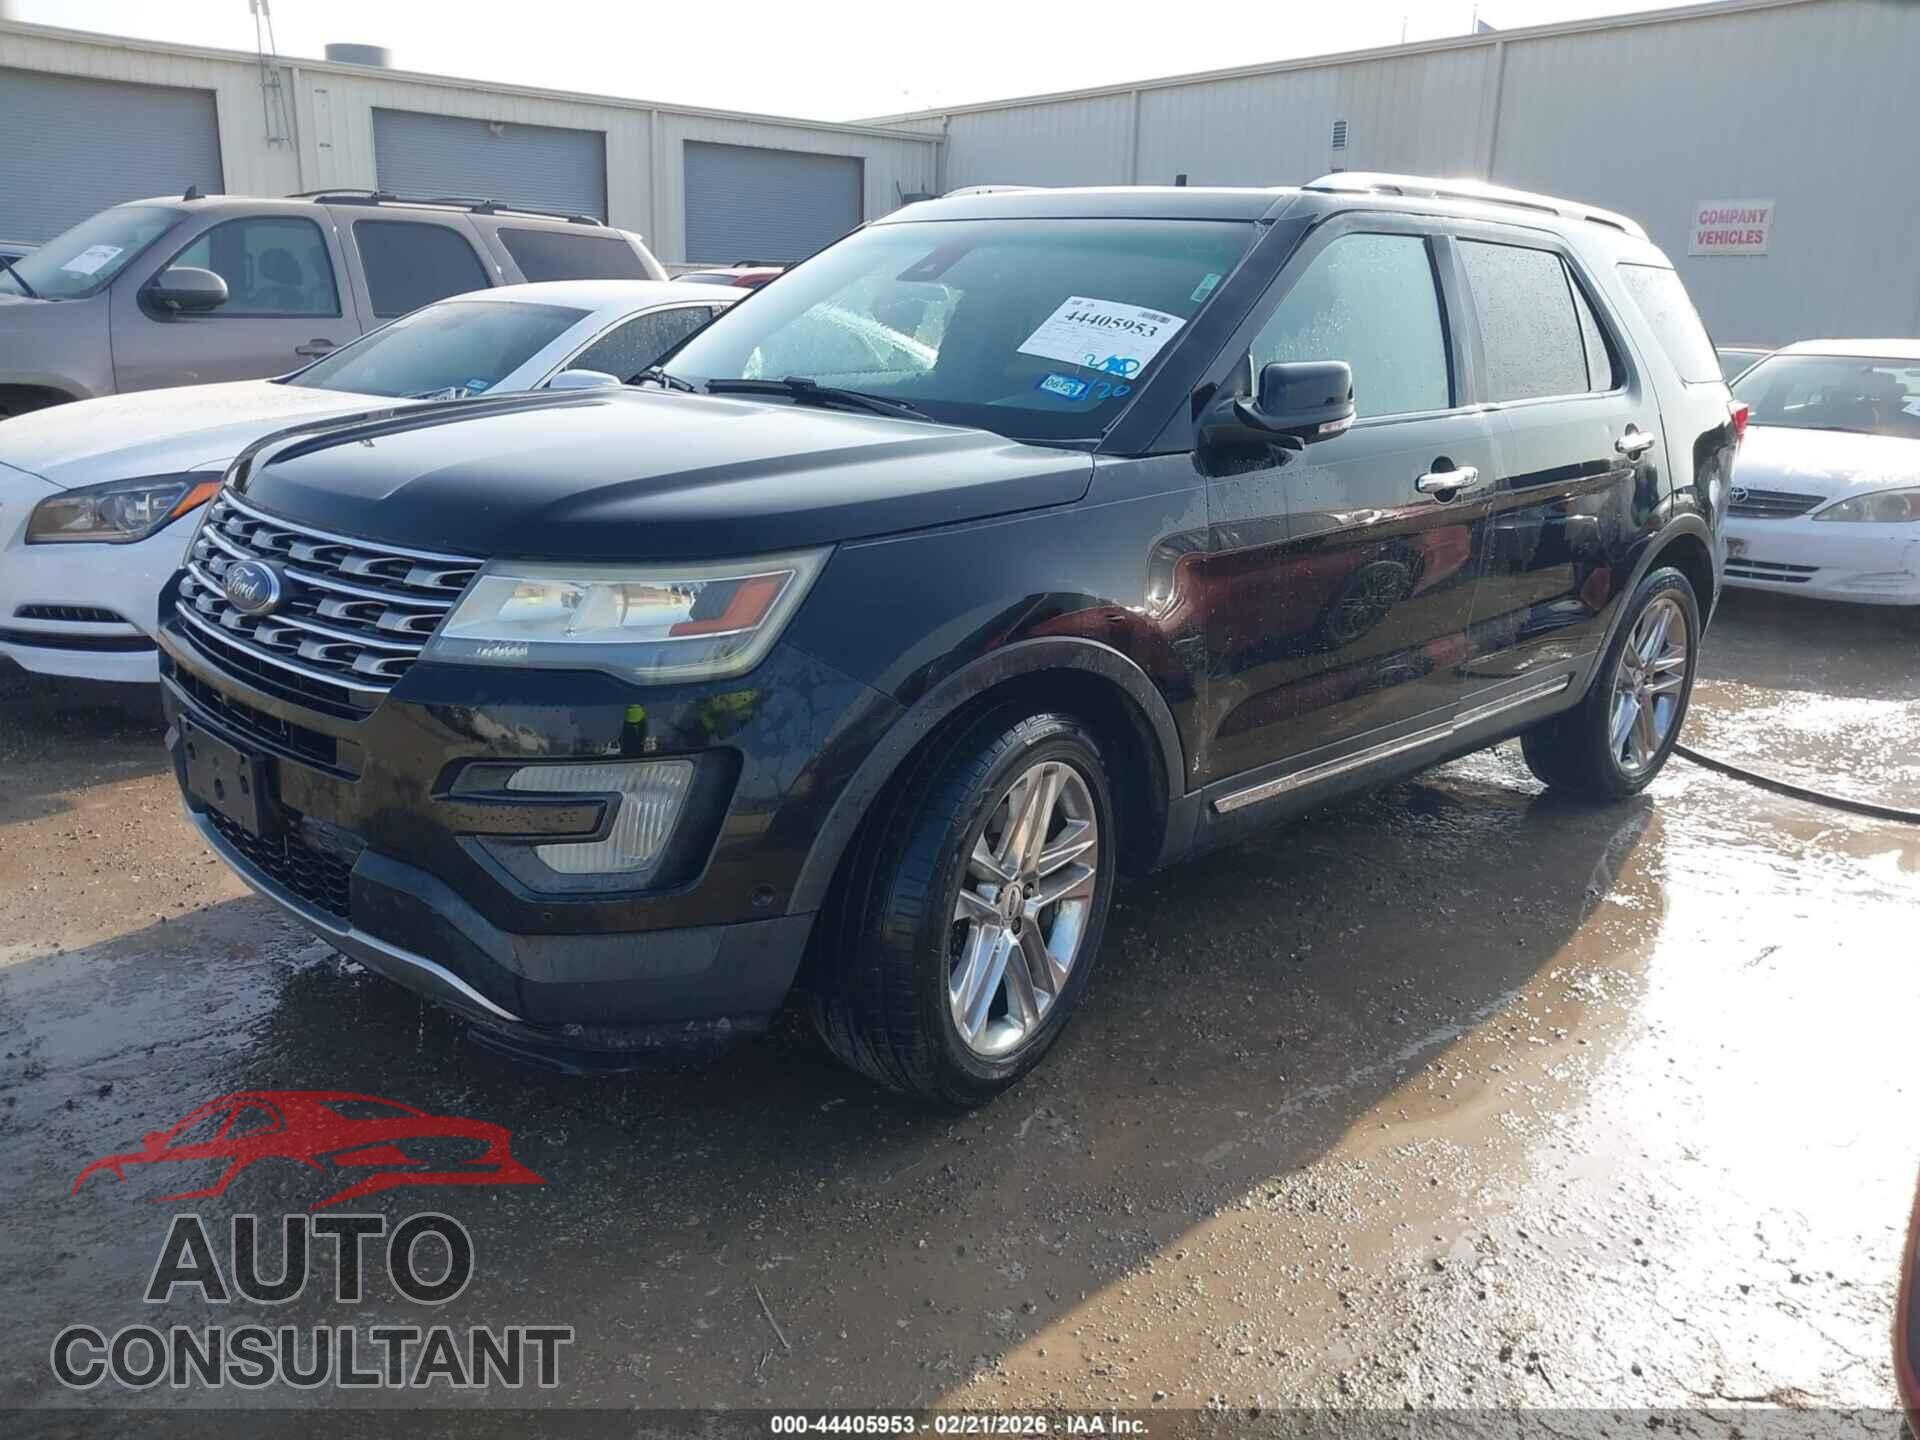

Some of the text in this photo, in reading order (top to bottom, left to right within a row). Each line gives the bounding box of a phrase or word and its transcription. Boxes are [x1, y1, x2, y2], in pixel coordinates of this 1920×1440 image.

[1699, 208, 1768, 225] COMPANY
[1697, 229, 1764, 245] VEHICLES
[1064, 310, 1159, 338] 44405953
[227, 566, 260, 601] Ford
